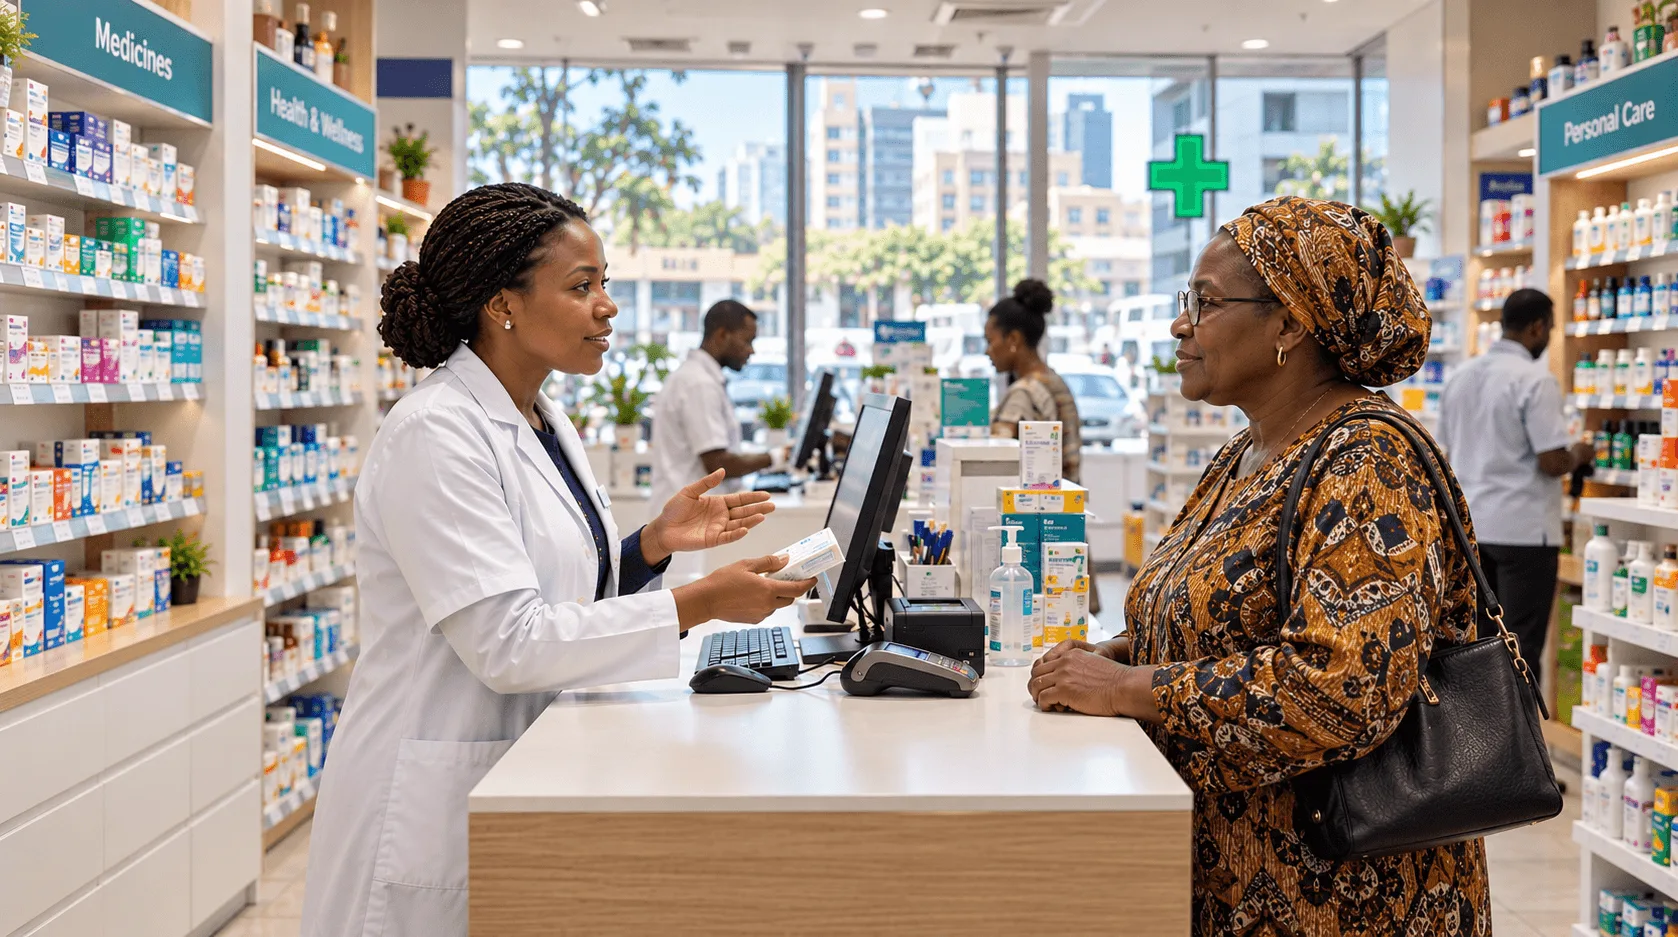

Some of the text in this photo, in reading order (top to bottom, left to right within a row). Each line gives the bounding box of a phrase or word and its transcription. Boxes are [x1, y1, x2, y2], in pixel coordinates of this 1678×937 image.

[95, 16, 173, 81] Medicines
[270, 87, 364, 155] Health & Wellness
[1564, 99, 1656, 147] Personal Care
